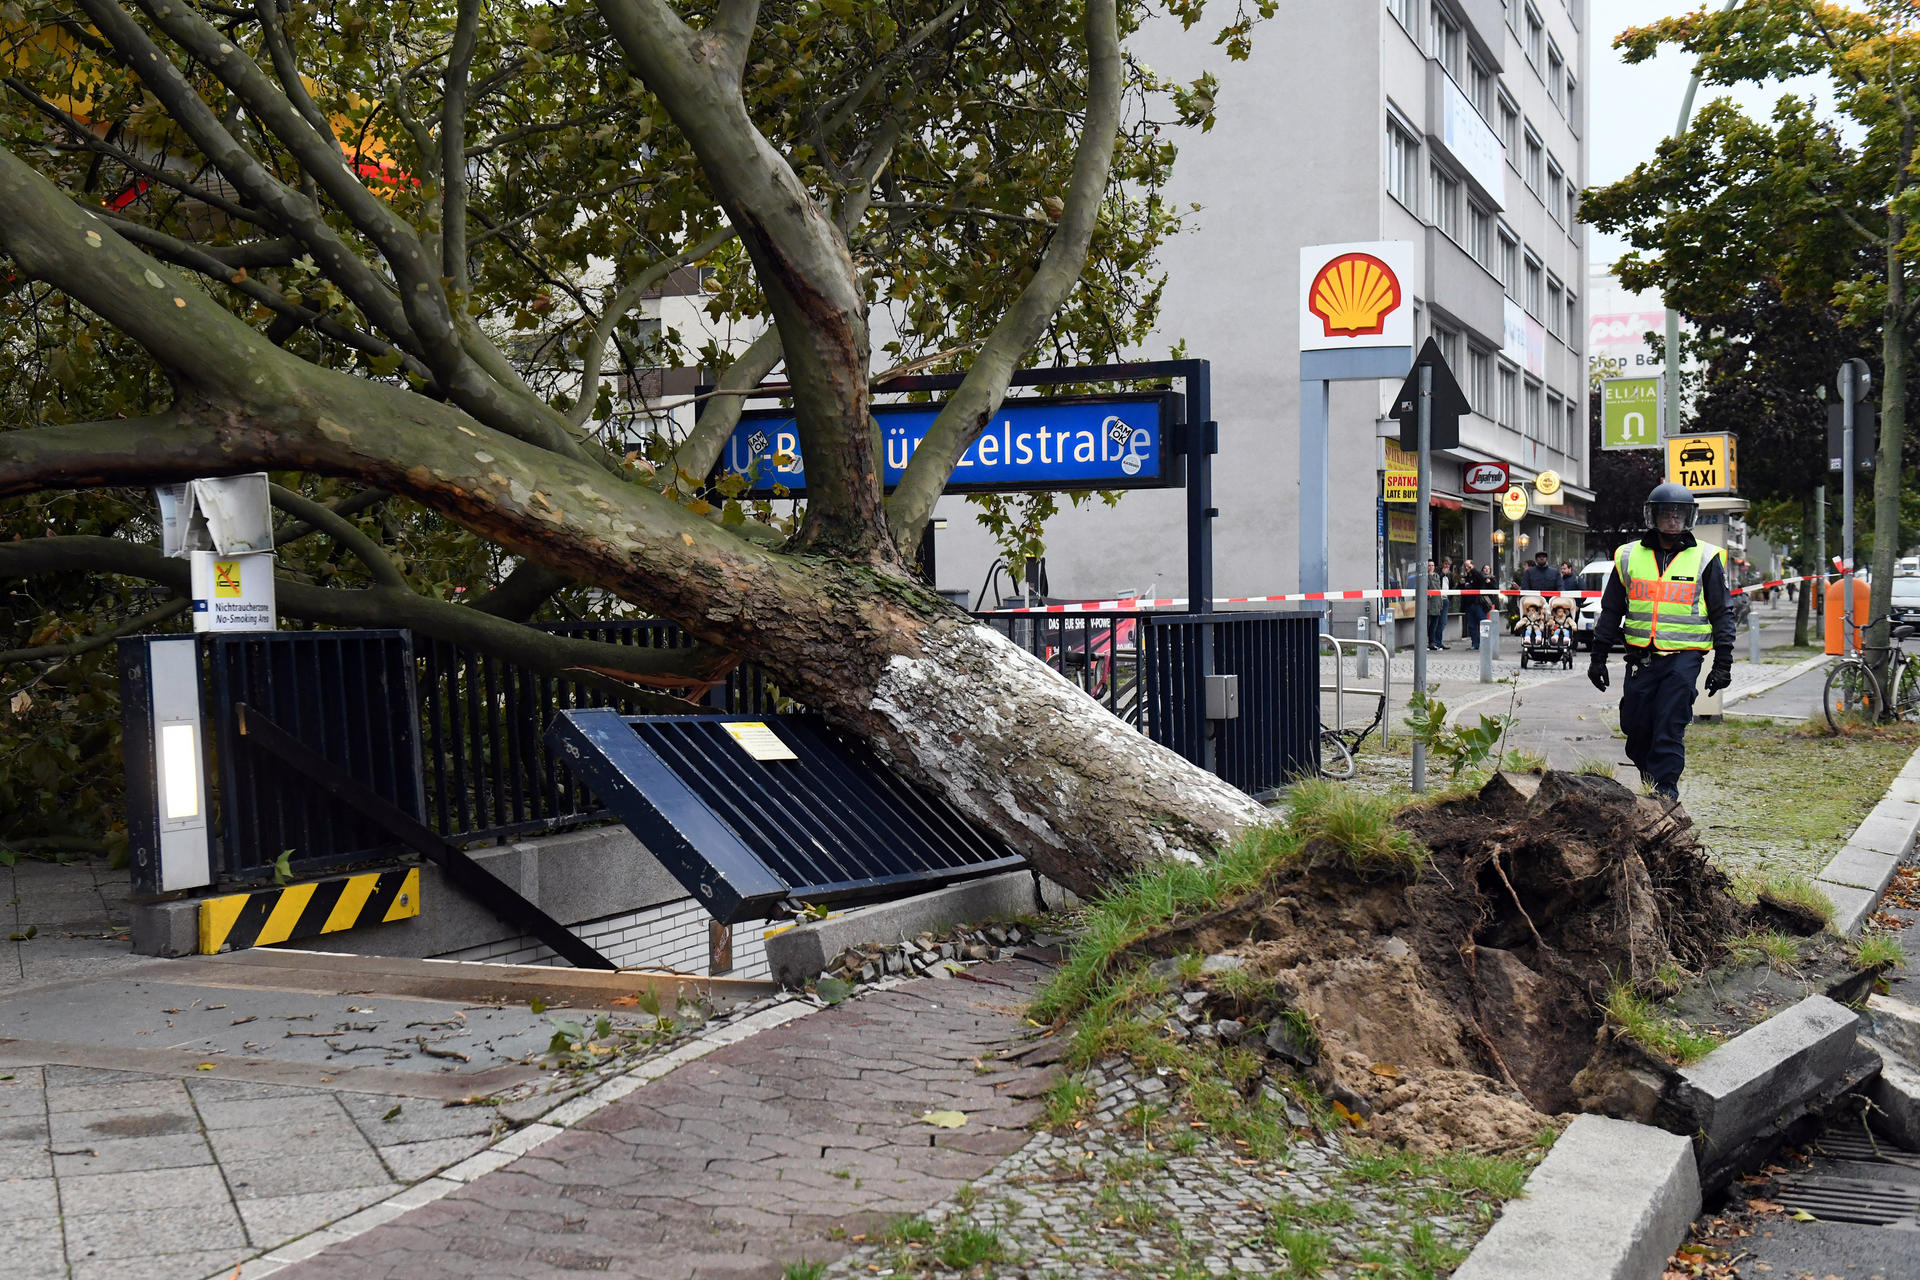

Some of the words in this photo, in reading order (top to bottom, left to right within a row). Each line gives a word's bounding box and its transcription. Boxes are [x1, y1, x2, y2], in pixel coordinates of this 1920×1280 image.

[1112, 430, 1126, 444] OK
[1387, 473, 1418, 487] SPÄTKA
[1679, 469, 1716, 487] TAXI
[1386, 489, 1401, 499] LATE
[1629, 580, 1696, 603] POLIZEI
[215, 602, 269, 612] Nichtraucherzone
[216, 614, 257, 625] No-Smoking
[1049, 618, 1059, 629] DAS
[1065, 618, 1074, 629] EUE
[1075, 618, 1084, 629] SHE
[1091, 618, 1110, 628] V-POWE
